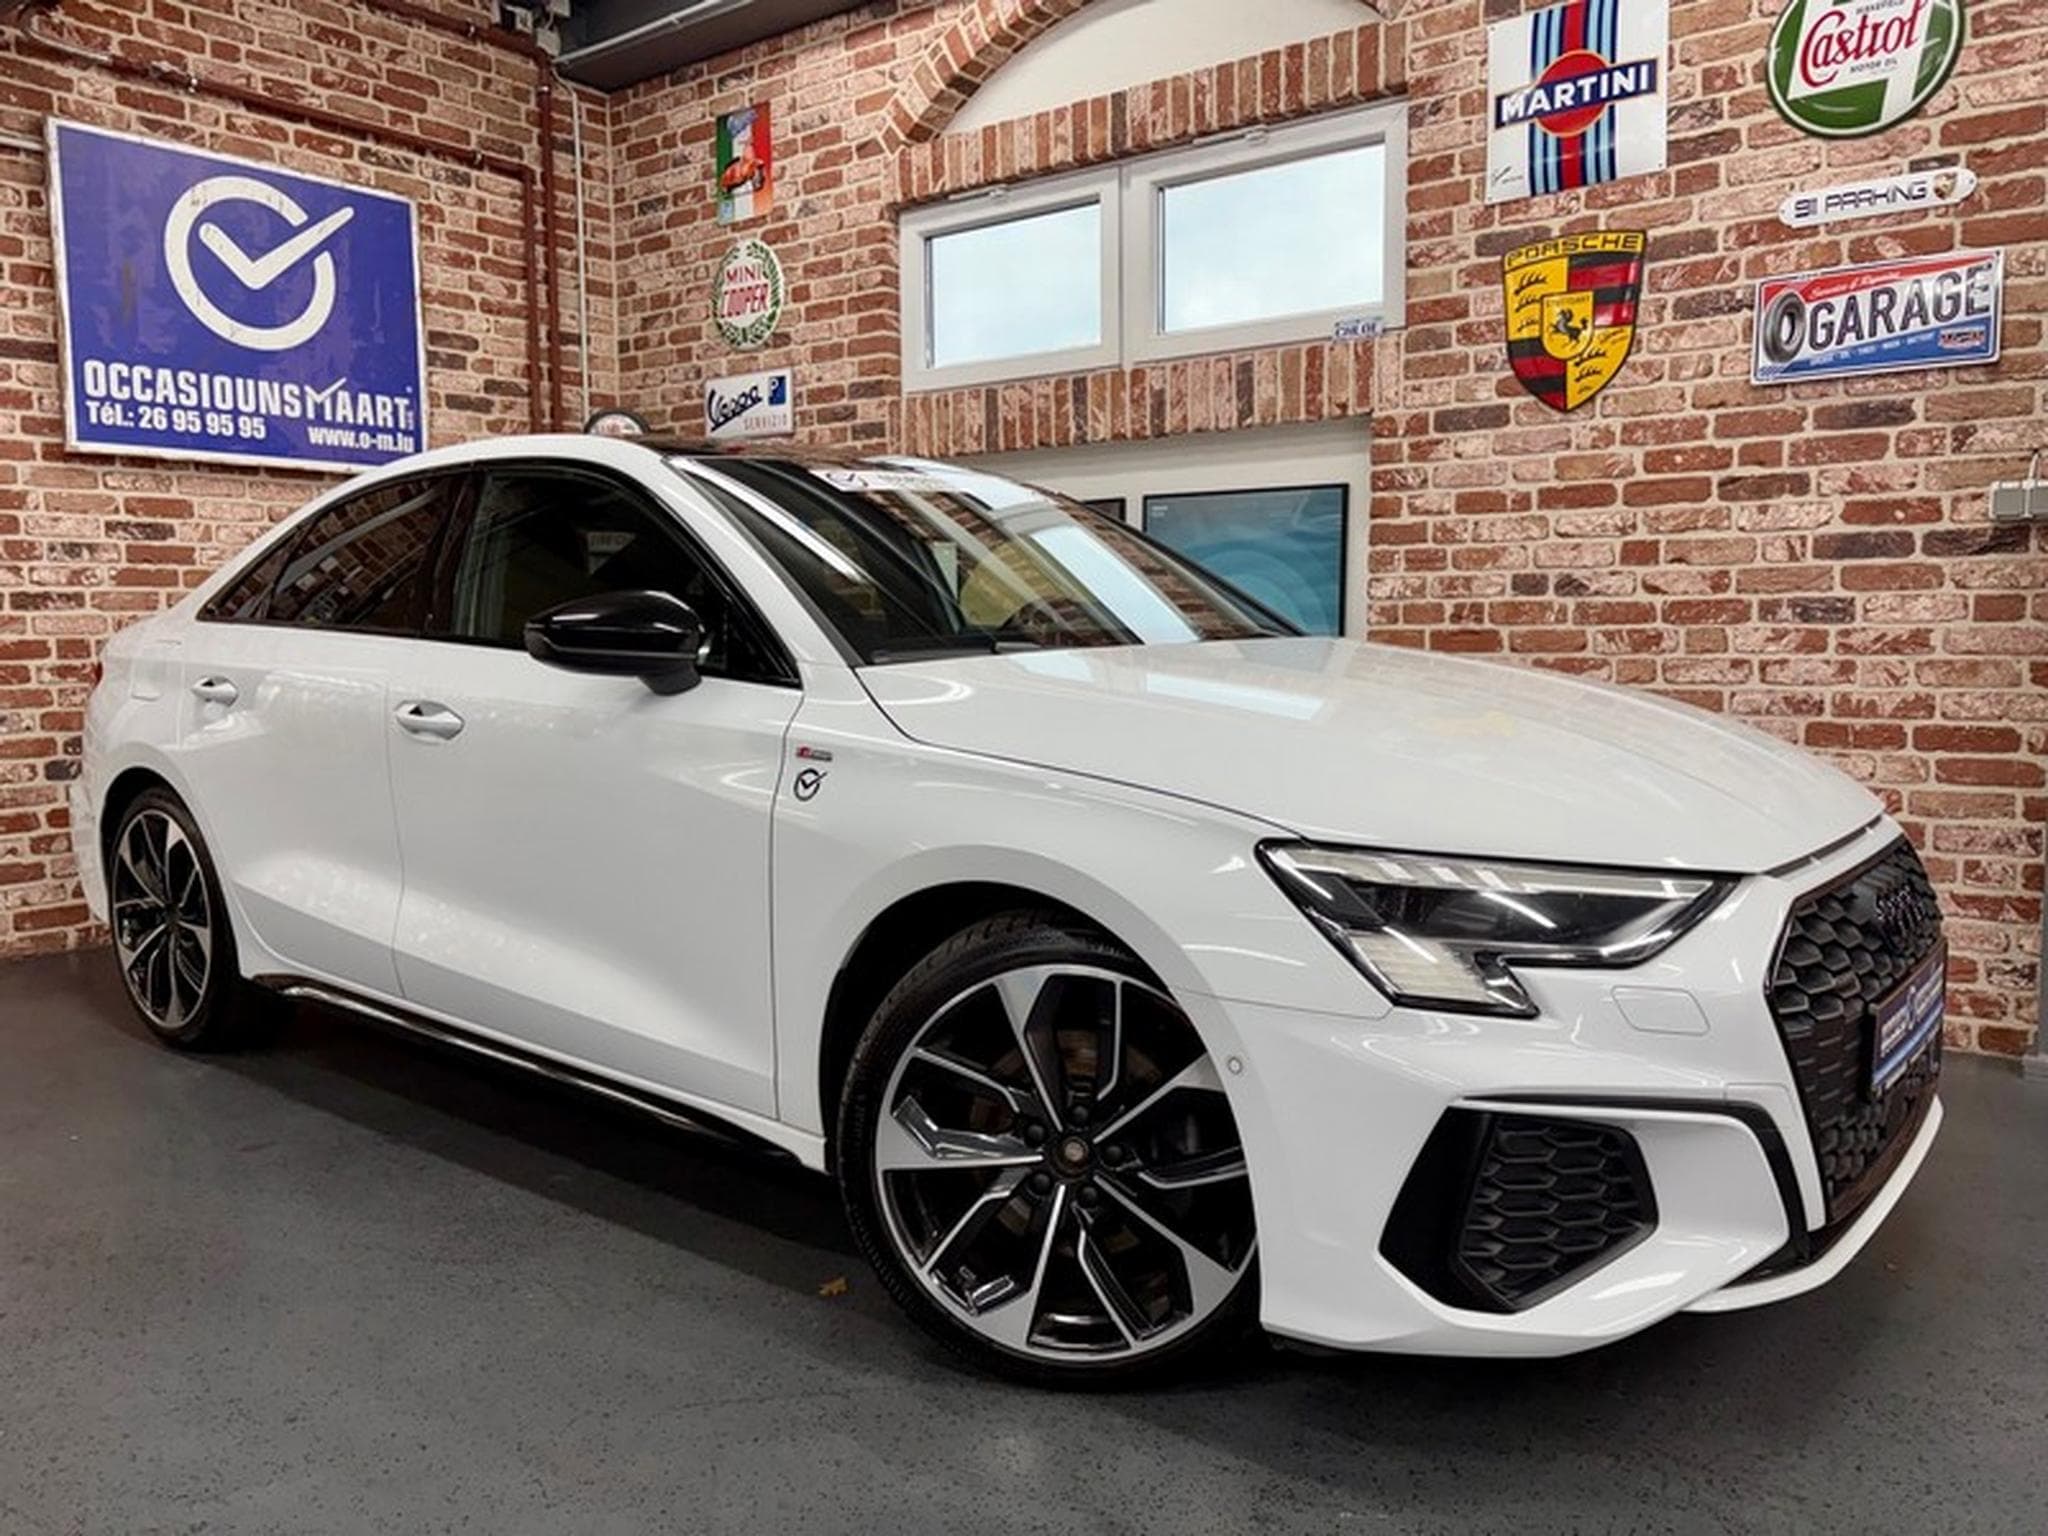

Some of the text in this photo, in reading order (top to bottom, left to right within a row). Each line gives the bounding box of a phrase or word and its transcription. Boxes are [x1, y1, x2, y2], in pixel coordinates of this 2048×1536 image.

[1800, 0, 1928, 88] Castrol
[1501, 64, 1649, 122] MARTINI
[1825, 180, 1927, 212] PARKING
[1507, 234, 1640, 267] PORSCHE
[726, 264, 761, 284] MINI
[1808, 262, 1993, 350] GARAGE
[138, 405, 168, 431] 26
[172, 408, 201, 434] 95
[206, 411, 234, 437] 95
[238, 415, 267, 440] 95
[709, 385, 763, 432] Vespa
[307, 426, 415, 453] www.o-m.lu
